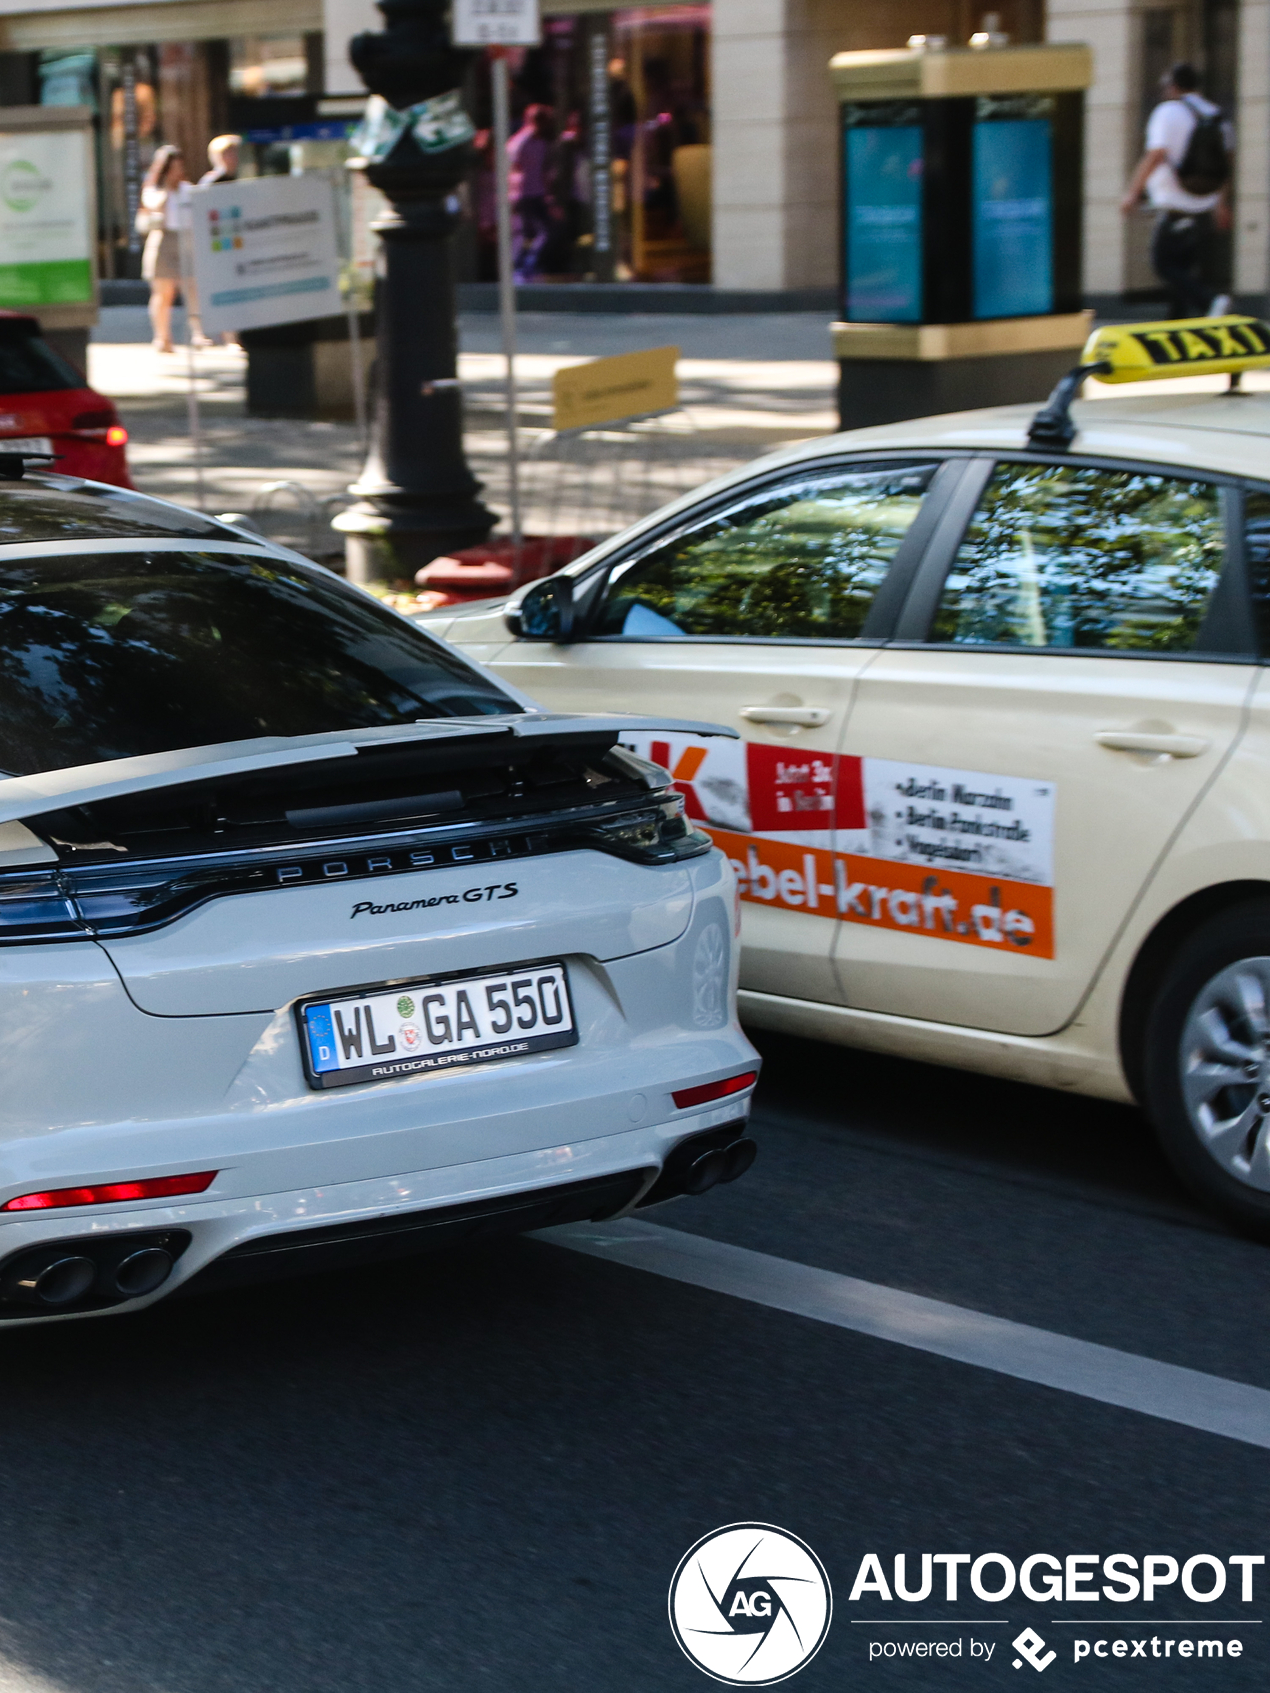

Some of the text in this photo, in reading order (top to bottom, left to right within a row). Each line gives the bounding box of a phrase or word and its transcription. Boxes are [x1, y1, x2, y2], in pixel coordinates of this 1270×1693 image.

[1144, 323, 1267, 361] TAXI
[776, 791, 793, 812] in
[904, 777, 946, 802] Berlin
[905, 805, 946, 830] Berlin
[350, 882, 518, 919] Panamera GTS
[334, 975, 562, 1060] WL GA 550
[319, 1046, 330, 1061] D
[372, 1041, 529, 1076] AUTOGALERIE-NORD.DE
